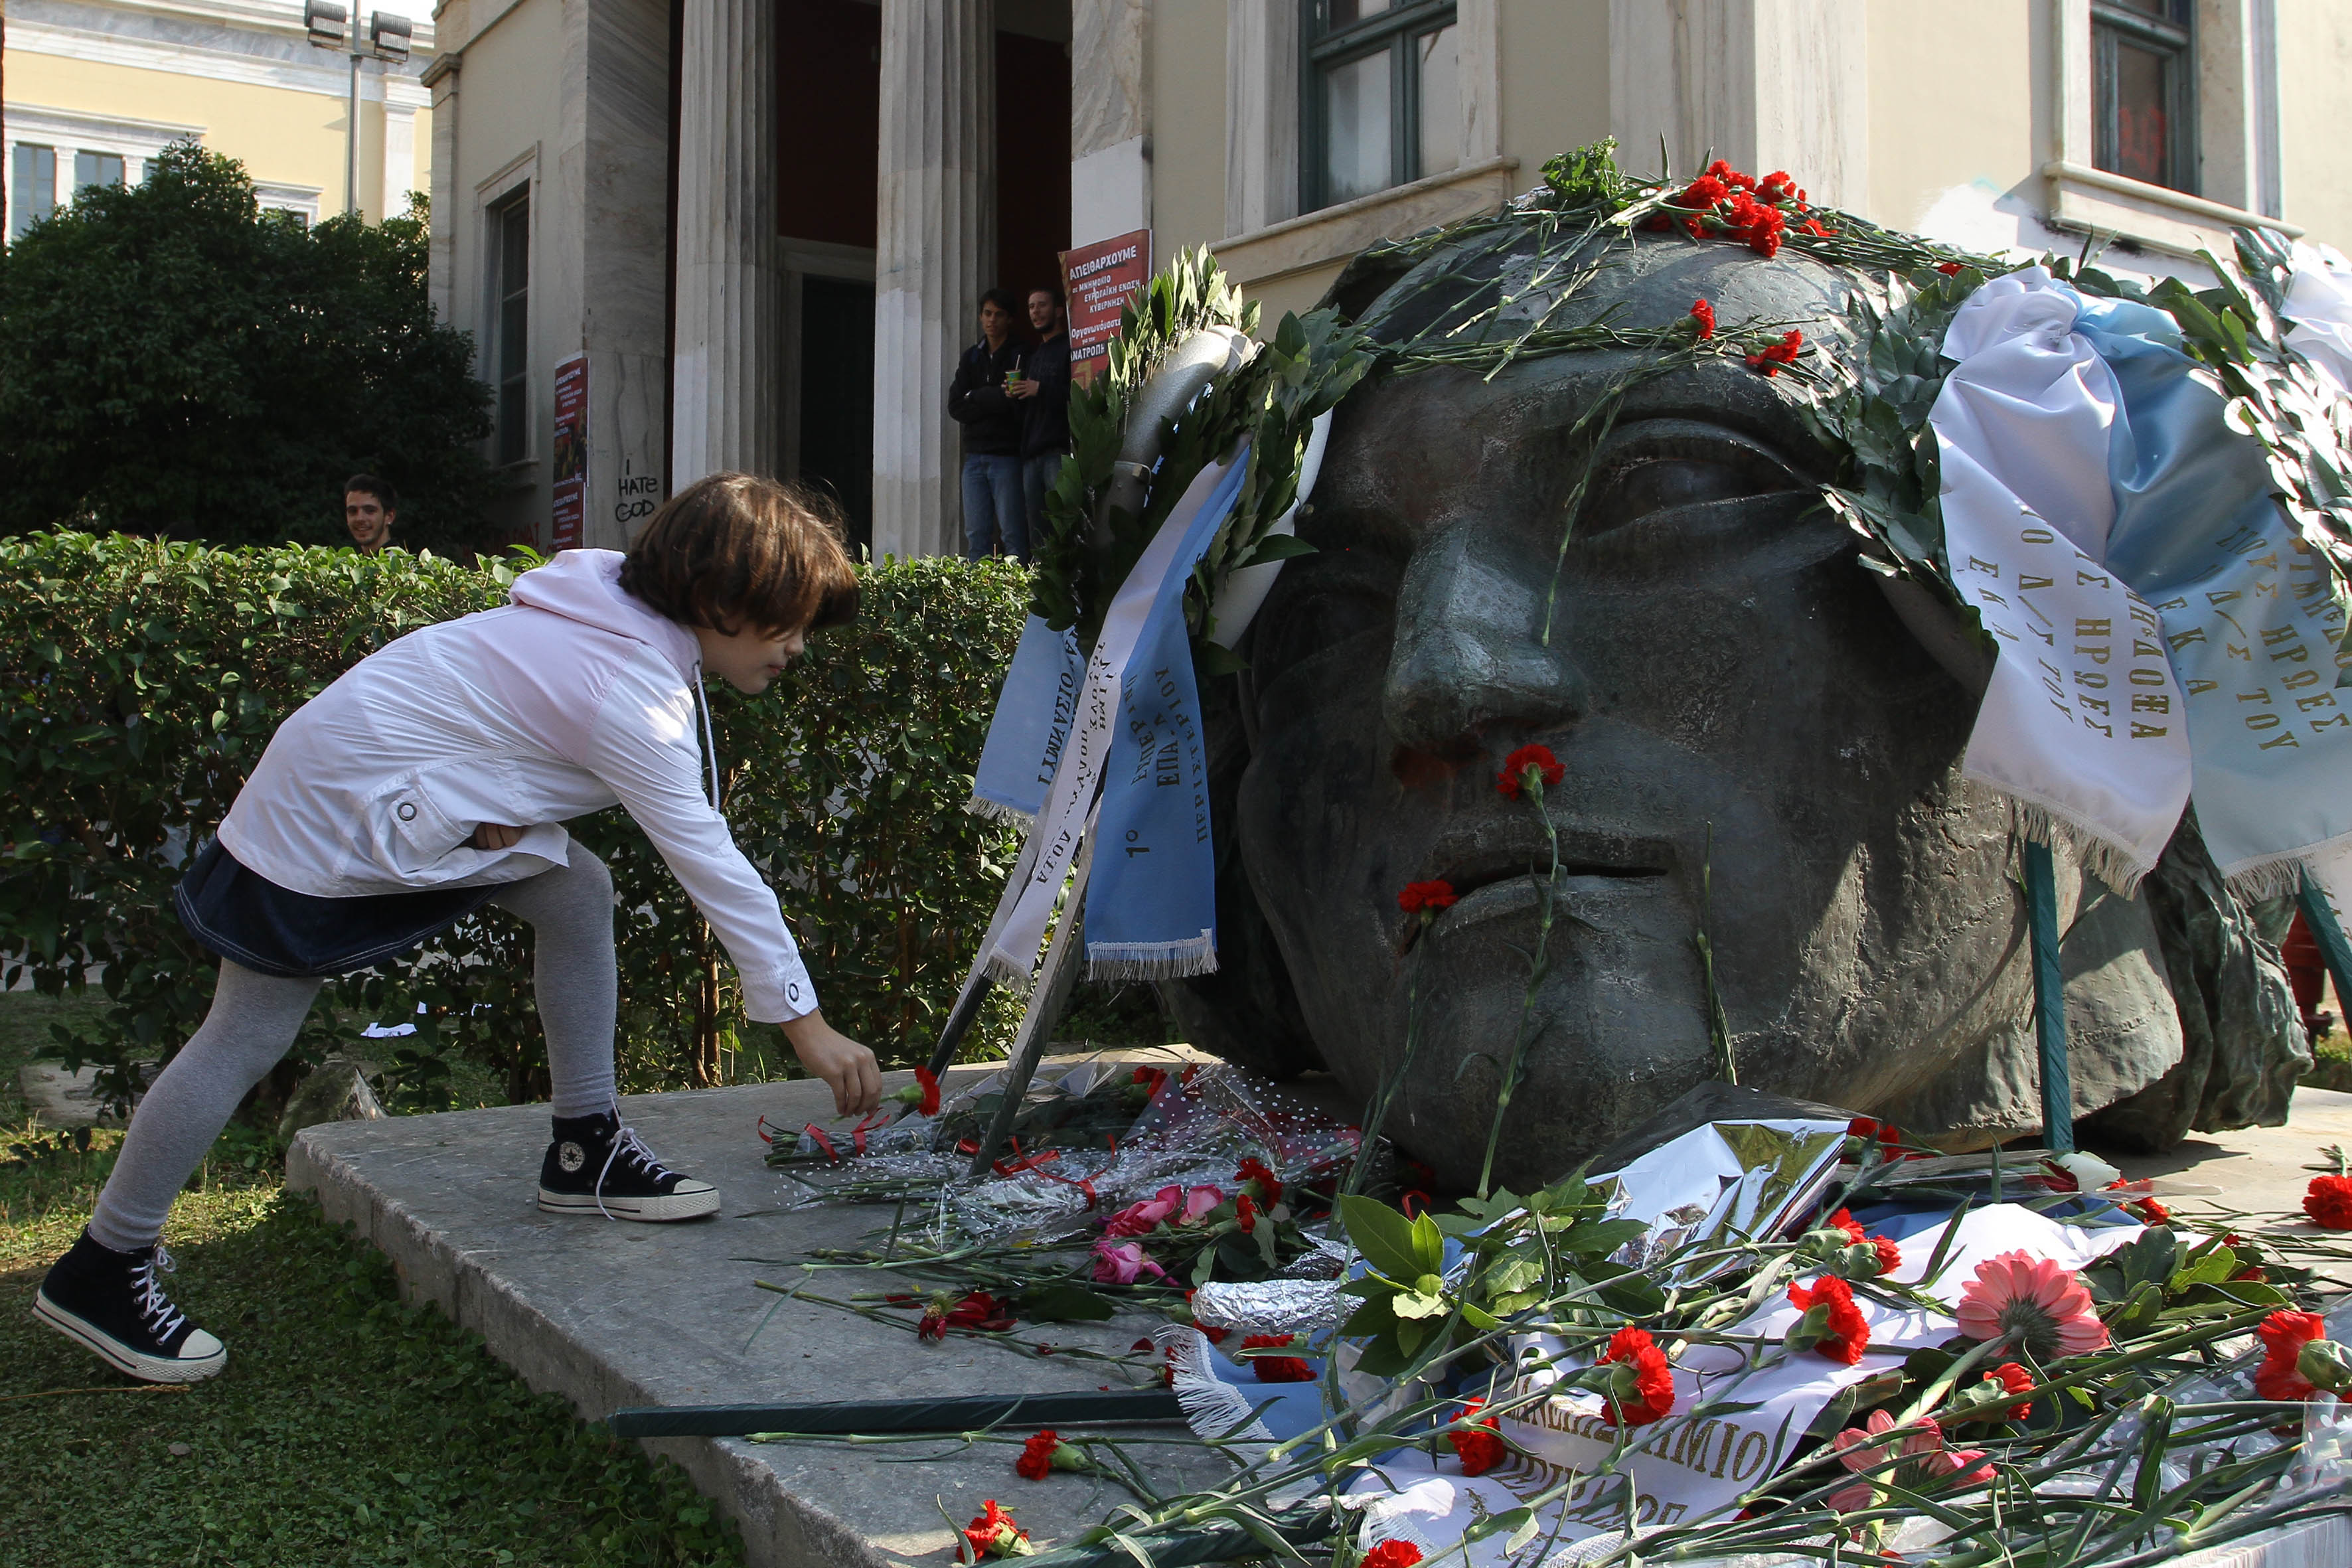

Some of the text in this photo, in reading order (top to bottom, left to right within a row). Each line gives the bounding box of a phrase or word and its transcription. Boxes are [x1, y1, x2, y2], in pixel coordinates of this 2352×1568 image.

[1069, 245, 1137, 280] ΑΠΕΙΘΑΡΧΟΥΜΕ
[1071, 318, 1122, 339] Οργανωνόμαστε
[1089, 296, 1125, 314] ΚΥΒΕΡΝΗΣΗ
[626, 458, 630, 475] I
[615, 499, 655, 523] GOD
[2017, 573, 2054, 647] Δ/Σ
[2038, 657, 2074, 724] ΤΟΥ
[2216, 525, 2352, 733] ΣΤΟΥΣ ΗΡΩΕΣ
[2074, 617, 2113, 739] ΗΡΩΕΣ
[2236, 686, 2300, 751] ΤΟΥ
[1154, 666, 1208, 844] ΠΕΡΙΣΤΕΡΙΟΥ
[1036, 829, 1071, 884] ΔΟΞΑ
